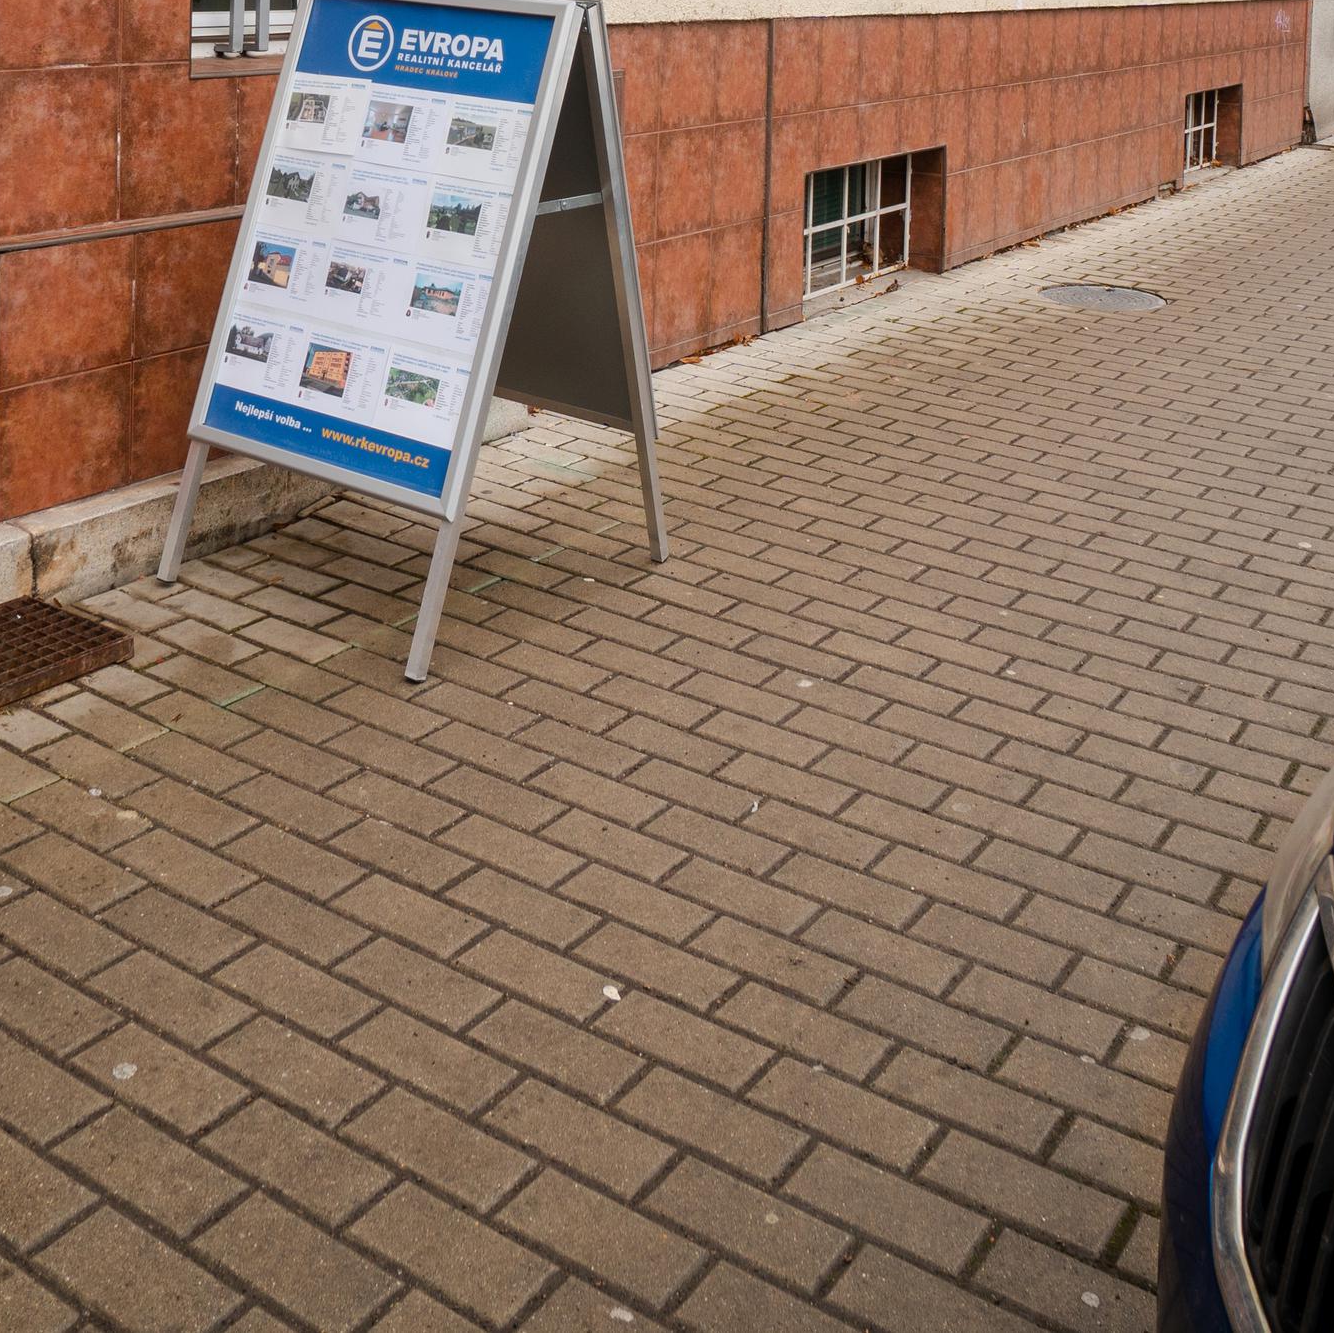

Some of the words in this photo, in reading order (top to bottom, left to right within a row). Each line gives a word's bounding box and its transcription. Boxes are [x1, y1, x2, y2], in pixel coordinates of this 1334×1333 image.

[399, 28, 504, 62] EVROPA
[394, 64, 424, 76] HRADEC
[397, 52, 444, 67] REALITNÍ
[447, 56, 503, 74] KANCELÁŘ
[234, 400, 274, 421] Nejlepší
[275, 414, 301, 430] volba
[321, 426, 430, 469] www.rkevropa.cz
